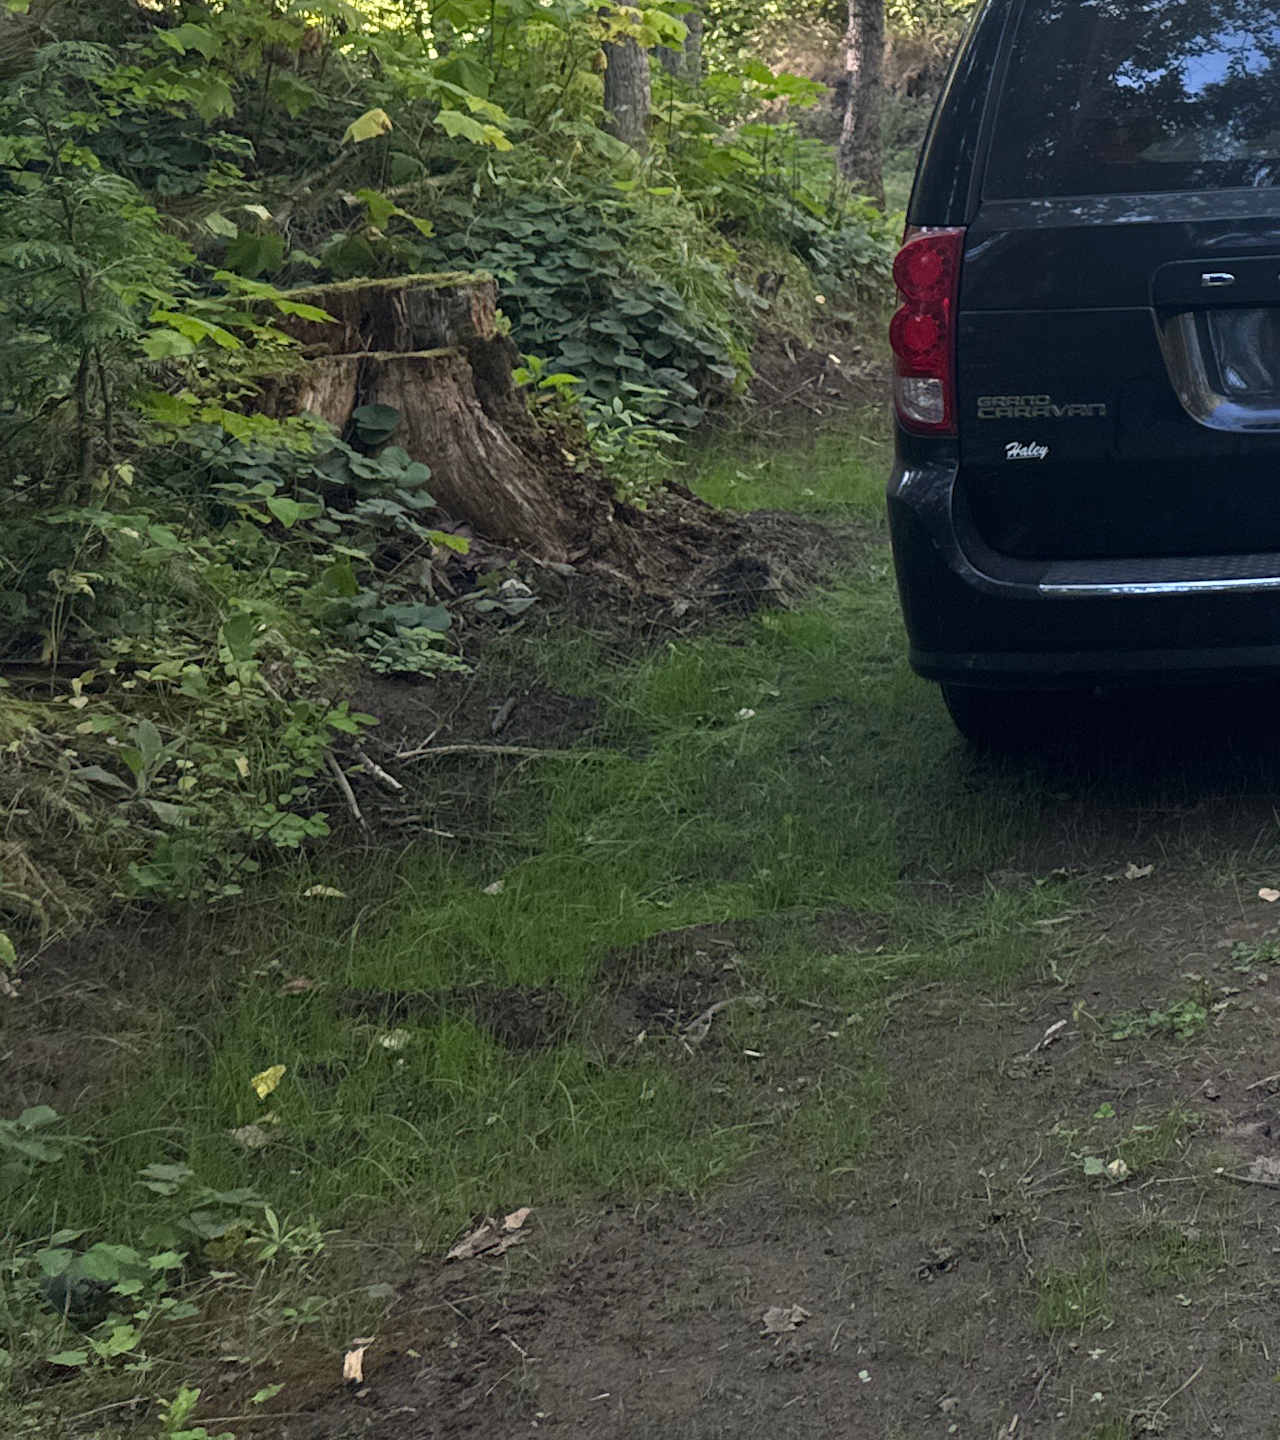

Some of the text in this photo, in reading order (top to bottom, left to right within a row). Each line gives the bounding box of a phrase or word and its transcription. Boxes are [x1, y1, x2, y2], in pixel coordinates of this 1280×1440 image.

[977, 395, 1050, 407] GRAND
[977, 403, 1107, 418] CARAVAN
[1005, 441, 1049, 460] Haley
